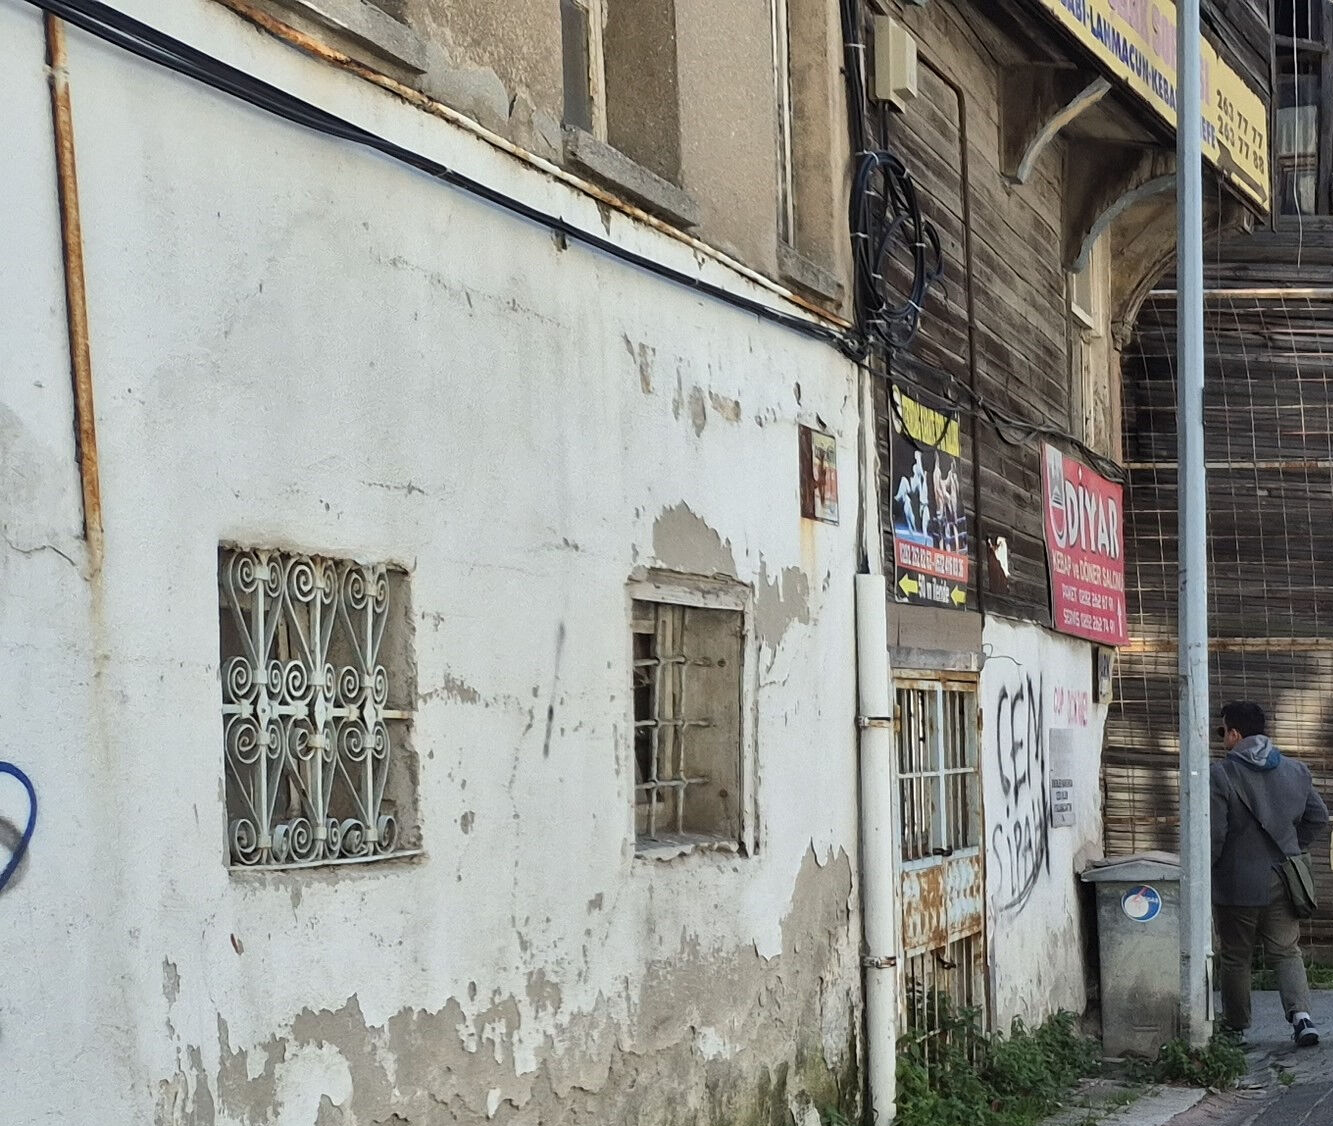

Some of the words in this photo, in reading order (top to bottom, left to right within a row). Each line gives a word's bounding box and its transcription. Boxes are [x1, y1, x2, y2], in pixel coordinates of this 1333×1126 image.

[1216, 89, 1234, 121] 263
[1237, 111, 1249, 136] 77
[1251, 121, 1263, 149] 77
[1217, 115, 1234, 148] 263
[1238, 136, 1249, 160] 77
[1253, 149, 1264, 175] 88
[1065, 464, 1120, 559] DİYAR
[1052, 549, 1072, 577] KEBAP
